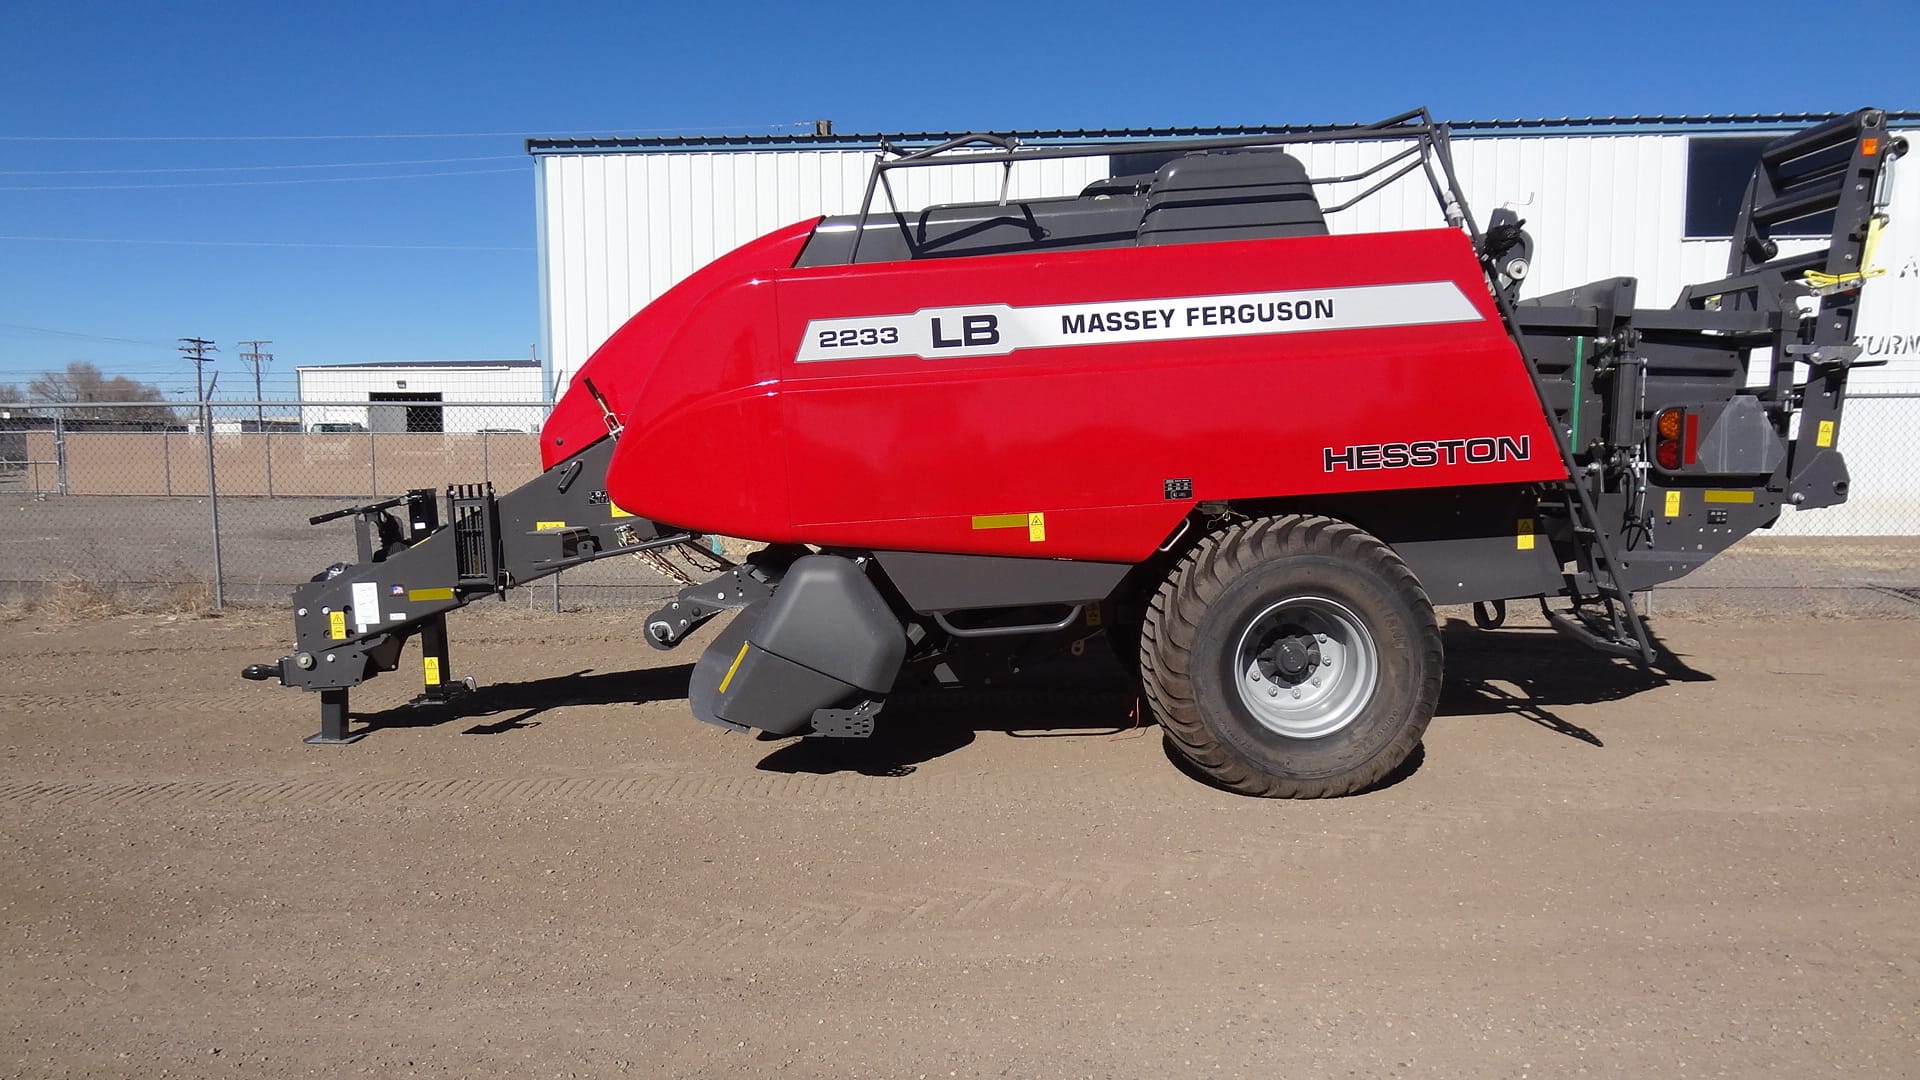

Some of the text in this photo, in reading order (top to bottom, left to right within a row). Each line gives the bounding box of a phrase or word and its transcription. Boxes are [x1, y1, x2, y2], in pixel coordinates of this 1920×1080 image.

[931, 314, 1000, 348] LB
[1061, 298, 1334, 334] MASSEY FERGUSON
[819, 326, 899, 348] 2233
[1323, 434, 1530, 472] HESSTON
